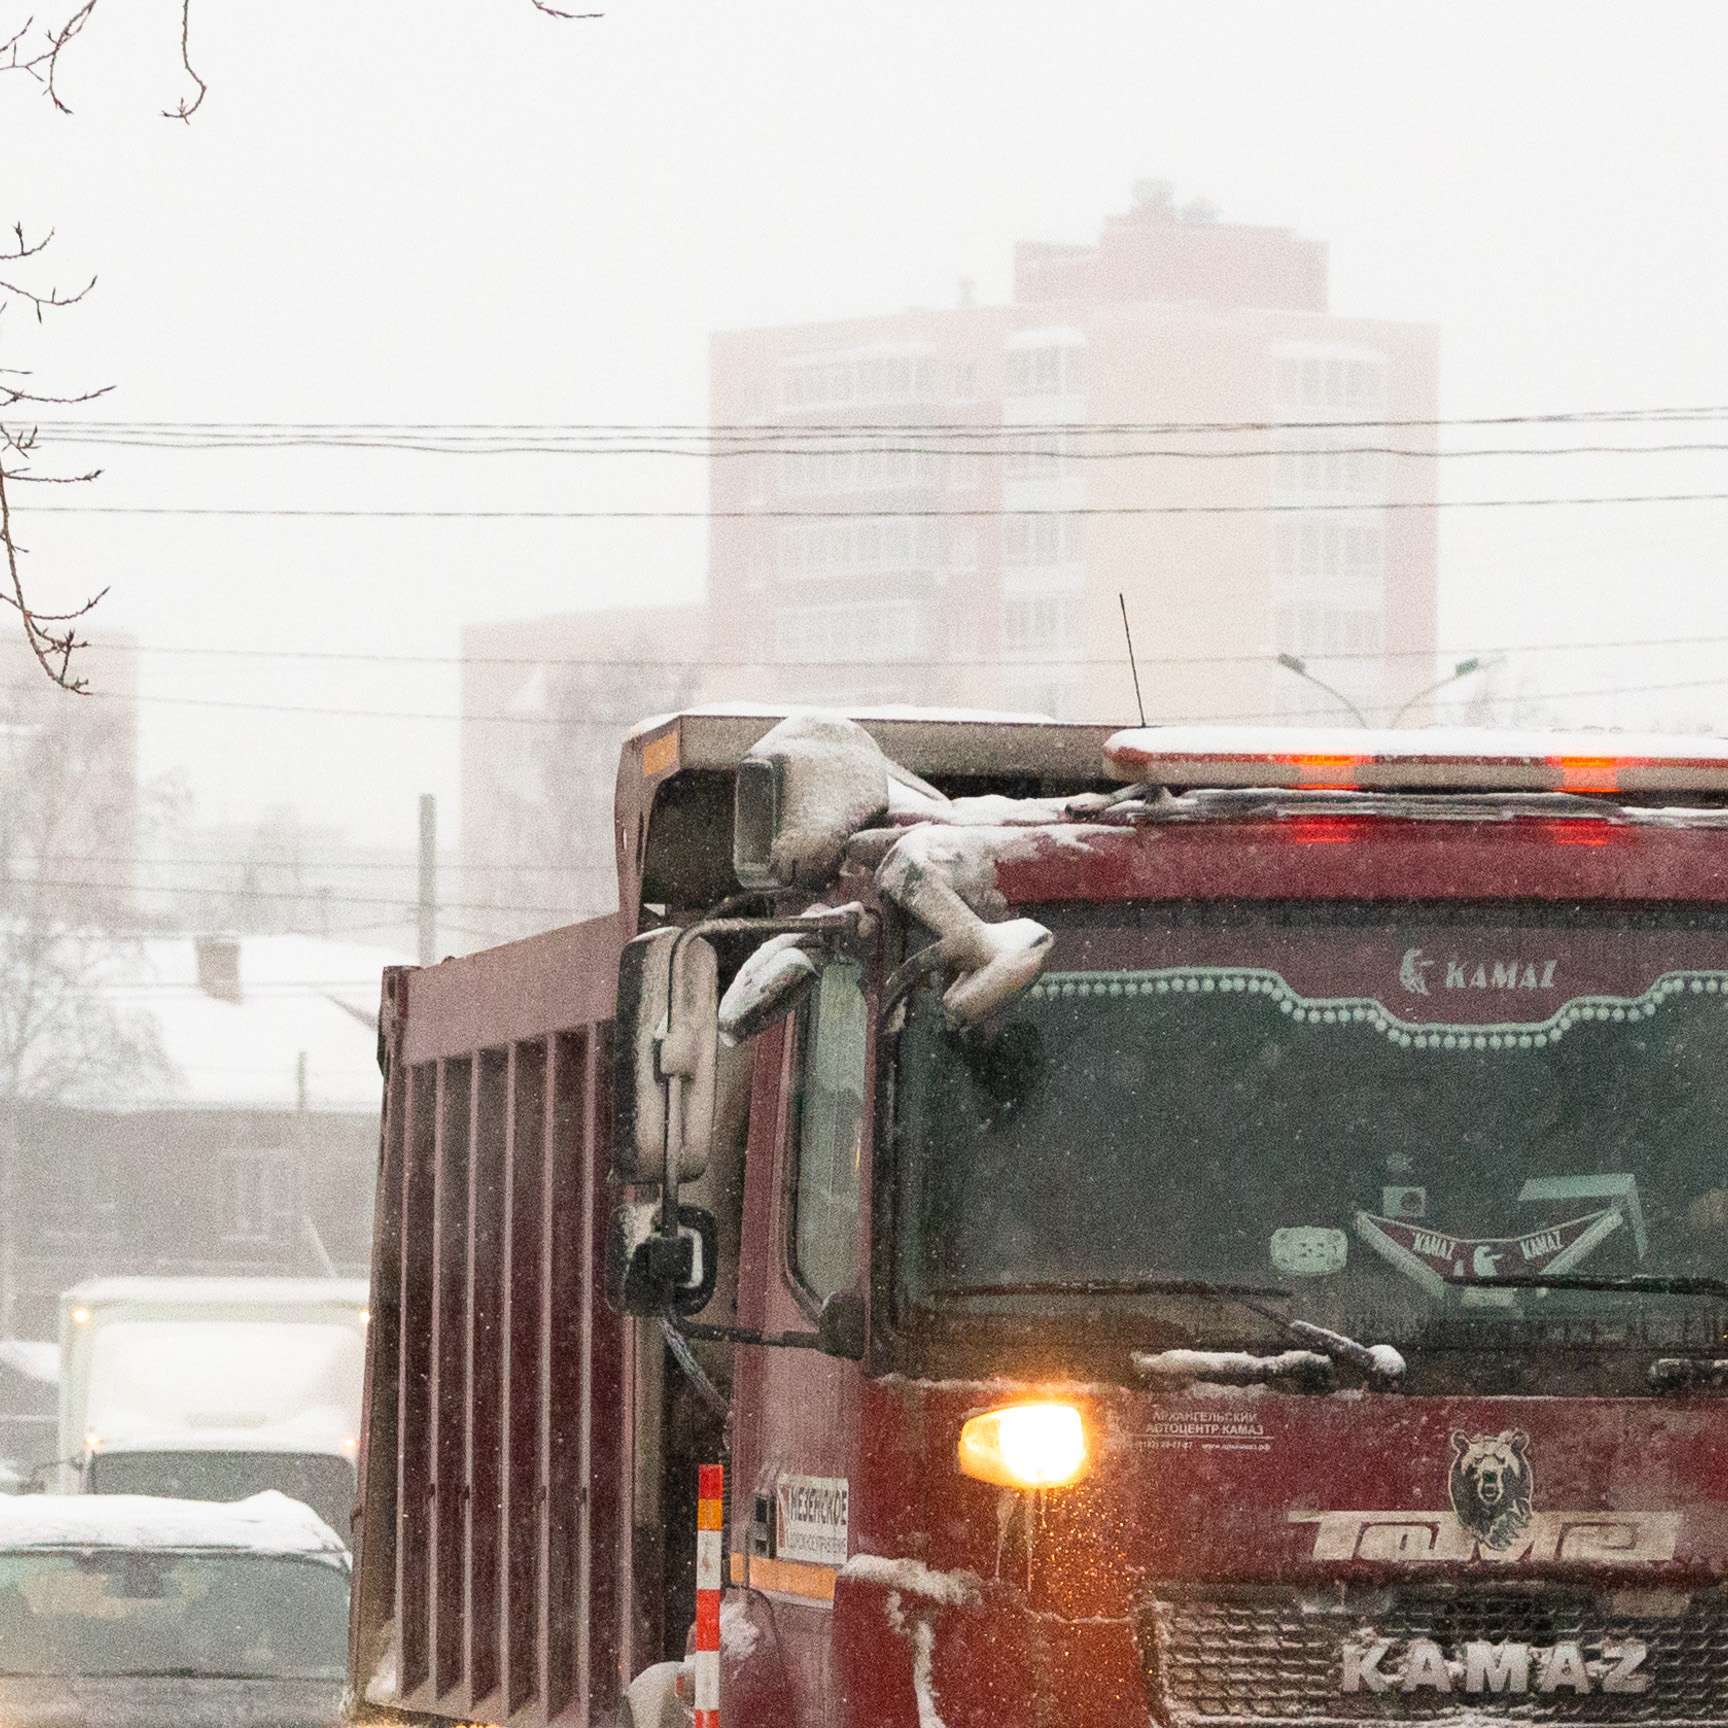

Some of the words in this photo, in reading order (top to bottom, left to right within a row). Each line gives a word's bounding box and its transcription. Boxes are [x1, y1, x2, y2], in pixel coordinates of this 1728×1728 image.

[1445, 958, 1558, 990] KAMAZ
[1412, 1231, 1457, 1260] KAMAZ
[1519, 1230, 1565, 1260] KAMAZ
[1222, 1424, 1265, 1436] КАМАЗ
[1341, 1638, 1650, 1694] KAMAZ
